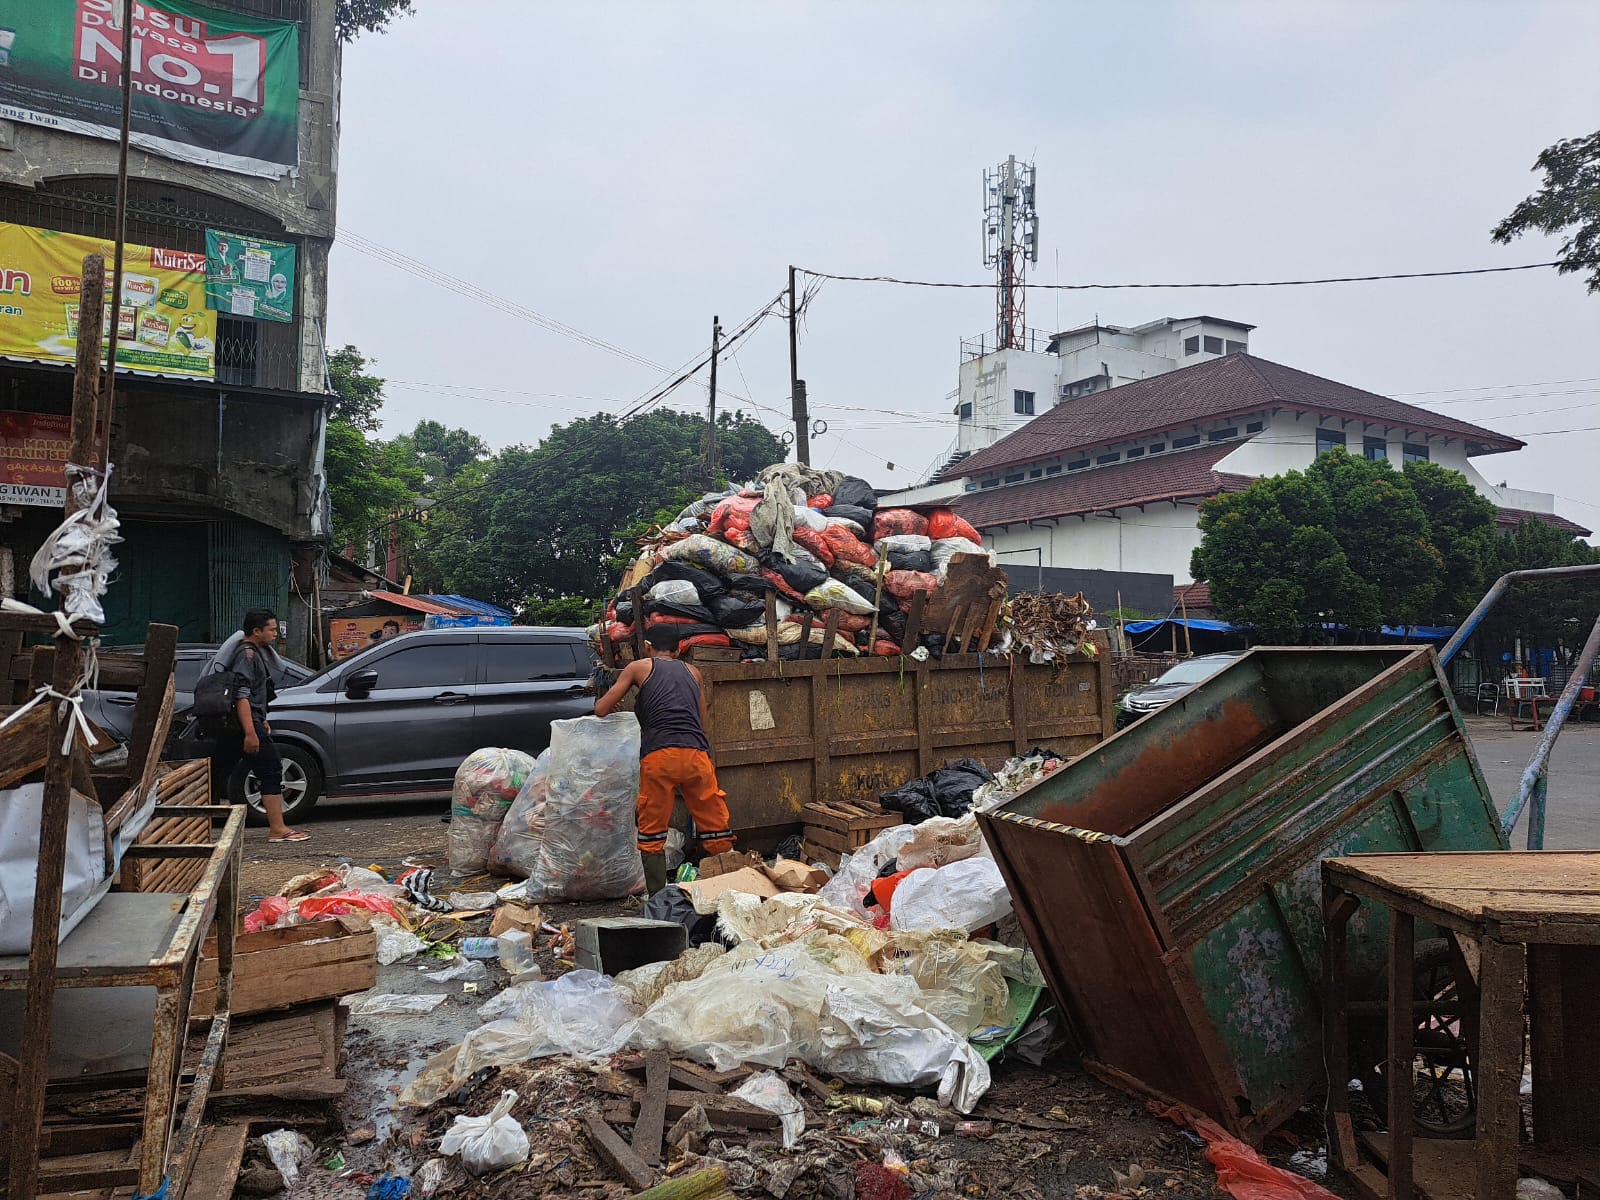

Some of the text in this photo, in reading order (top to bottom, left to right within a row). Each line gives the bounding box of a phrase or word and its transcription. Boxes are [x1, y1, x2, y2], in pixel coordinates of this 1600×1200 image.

[78, 66, 107, 83] Di
[79, 27, 260, 103] No.1
[0, 105, 25, 120] ang
[29, 112, 58, 126] Iwan
[12, 486, 51, 497] IWAN
[55, 489, 62, 498] 1
